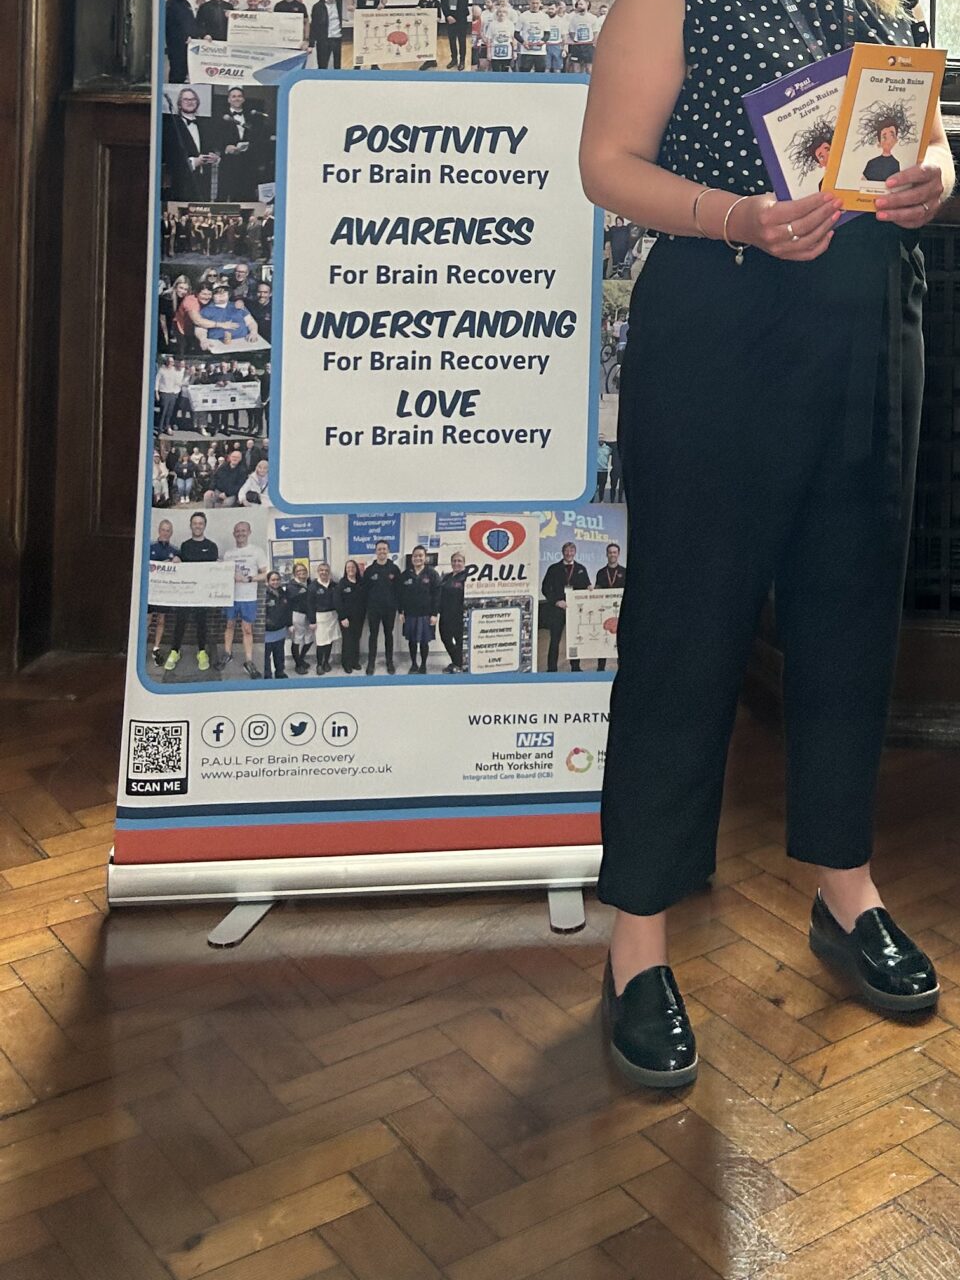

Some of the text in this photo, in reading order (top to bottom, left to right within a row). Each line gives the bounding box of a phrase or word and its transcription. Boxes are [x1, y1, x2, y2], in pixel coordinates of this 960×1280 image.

[777, 88, 838, 122] One Punch Ruins
[800, 105, 820, 119] Lives
[344, 124, 528, 154] POSITIVITY
[322, 164, 549, 189] For Brain Recovery
[330, 216, 534, 245] AWARENESS
[329, 265, 556, 289] For Brain Recovery
[300, 310, 576, 340] UNDERSTANDING
[323, 351, 550, 374] For Brain Recovery
[396, 389, 480, 418] LOVE
[325, 425, 551, 448] For Brain Recovery
[562, 510, 604, 530] Paul
[464, 564, 527, 582] P.A.U.L
[468, 712, 611, 725] WORKING IN PARTN
[517, 733, 552, 746] NHS
[202, 753, 355, 767] P.A.U.L For Brain Recovery
[492, 751, 553, 760] Humber and
[200, 764, 392, 781] www.paulforbrainrecovery.co.uk
[475, 762, 553, 771] North Yorkshire
[131, 780, 181, 792] SCAN ME
